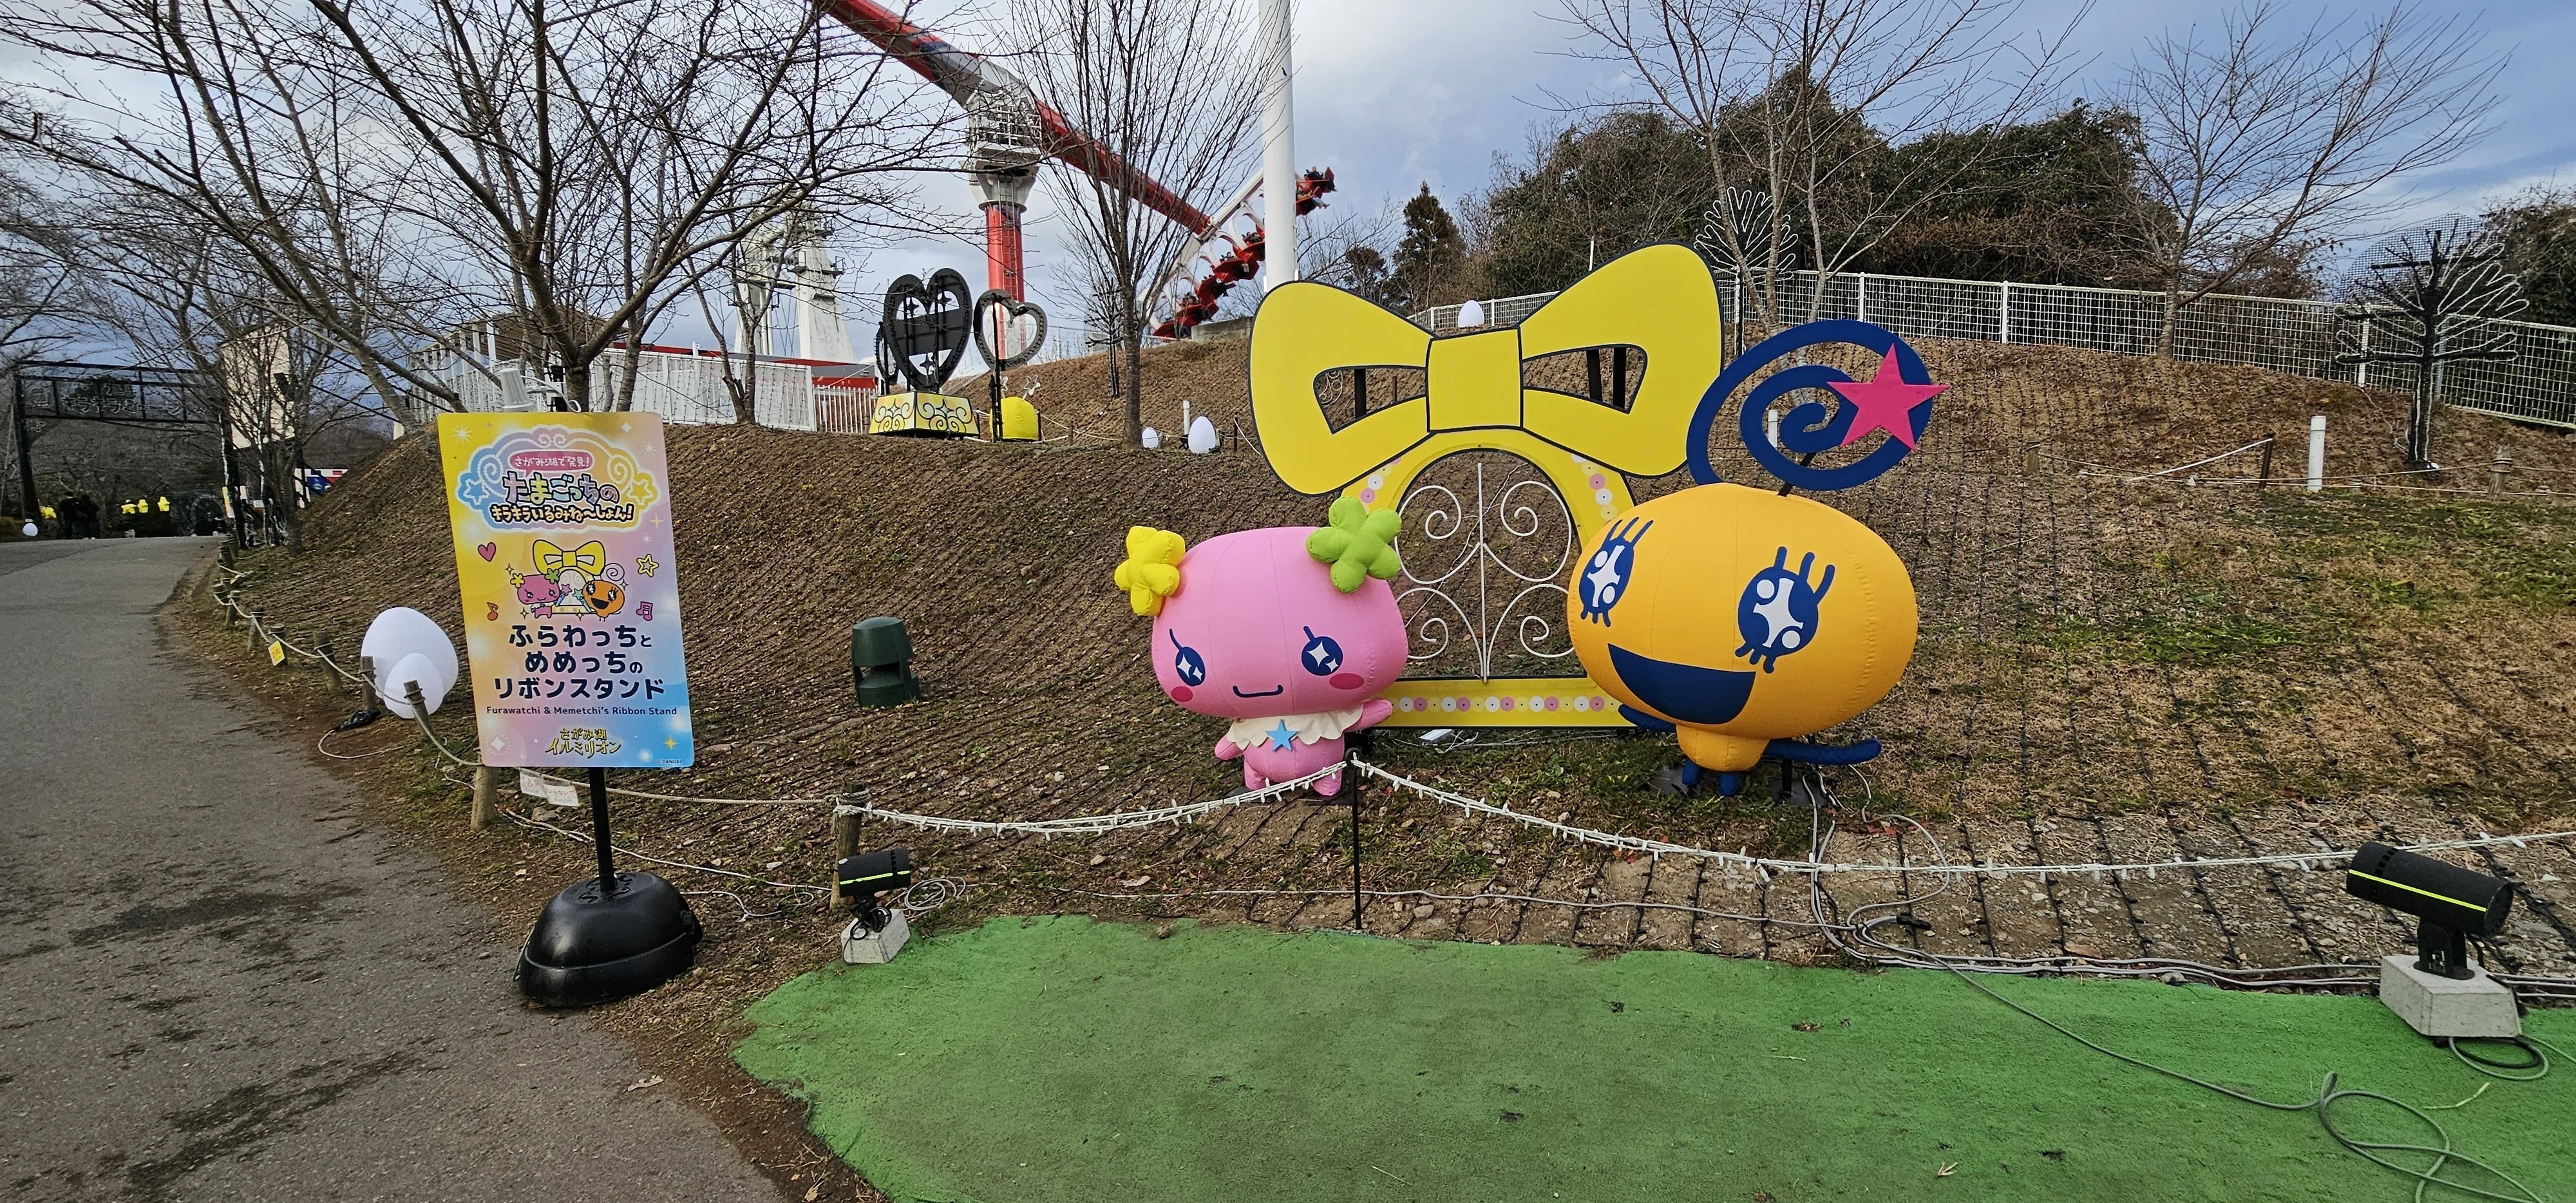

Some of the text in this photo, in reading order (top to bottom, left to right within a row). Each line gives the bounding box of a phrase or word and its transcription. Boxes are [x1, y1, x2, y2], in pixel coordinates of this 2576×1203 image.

[515, 455, 590, 468] さがみ湖で発見!
[502, 471, 620, 505] たまごっちの
[509, 625, 652, 648] ふらわっちと
[525, 650, 643, 674] めめっちの
[494, 677, 665, 700] リボンスタンド
[553, 706, 609, 715] Memetchi's
[612, 706, 646, 715] Ribbon
[560, 728, 607, 740] さがみ湖
[545, 737, 621, 758] イルミリオン
